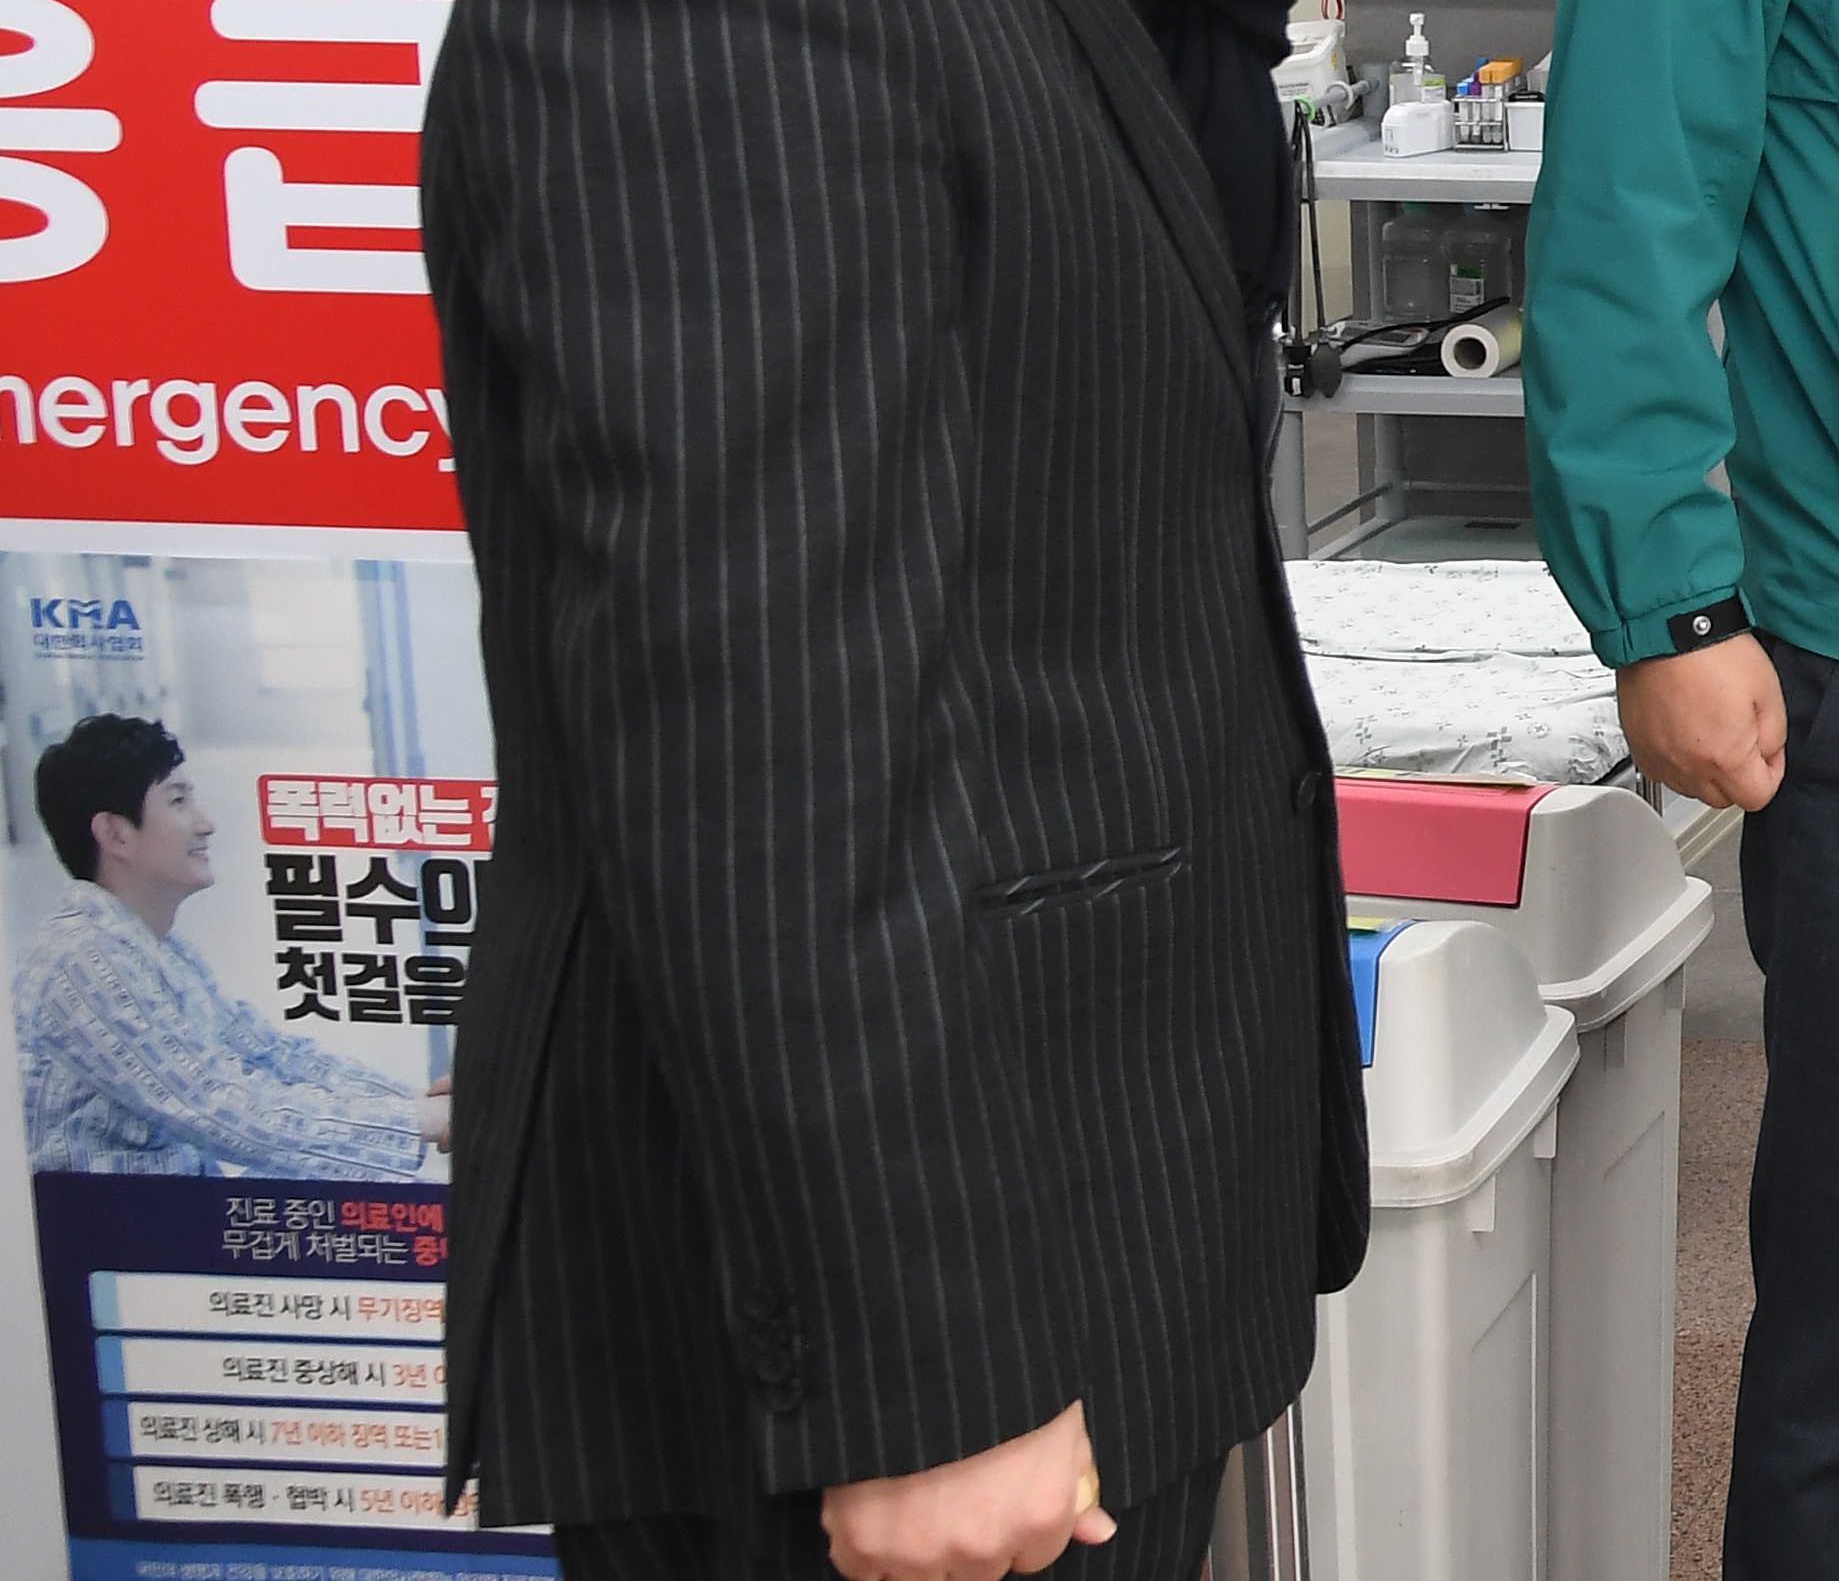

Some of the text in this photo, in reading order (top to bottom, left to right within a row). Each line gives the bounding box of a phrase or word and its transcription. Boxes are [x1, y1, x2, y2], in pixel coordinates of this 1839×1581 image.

[31, 598, 140, 630] KMA
[266, 780, 471, 845] 폭력없는
[225, 1197, 279, 1228] 진료
[283, 1198, 335, 1230] 중인
[222, 1230, 301, 1262] 무겁게
[305, 1232, 409, 1265] 처벌되는
[209, 1291, 273, 1317] 의료진
[280, 1294, 322, 1320] 사망
[329, 1295, 350, 1321] 시
[222, 1356, 288, 1383] 의료진
[293, 1358, 357, 1385] 중상해
[364, 1361, 386, 1387] 시
[140, 1415, 198, 1442] 의료진
[246, 1419, 265, 1445] 시
[153, 1480, 216, 1507] 의료진
[223, 1482, 265, 1509] 폭행
